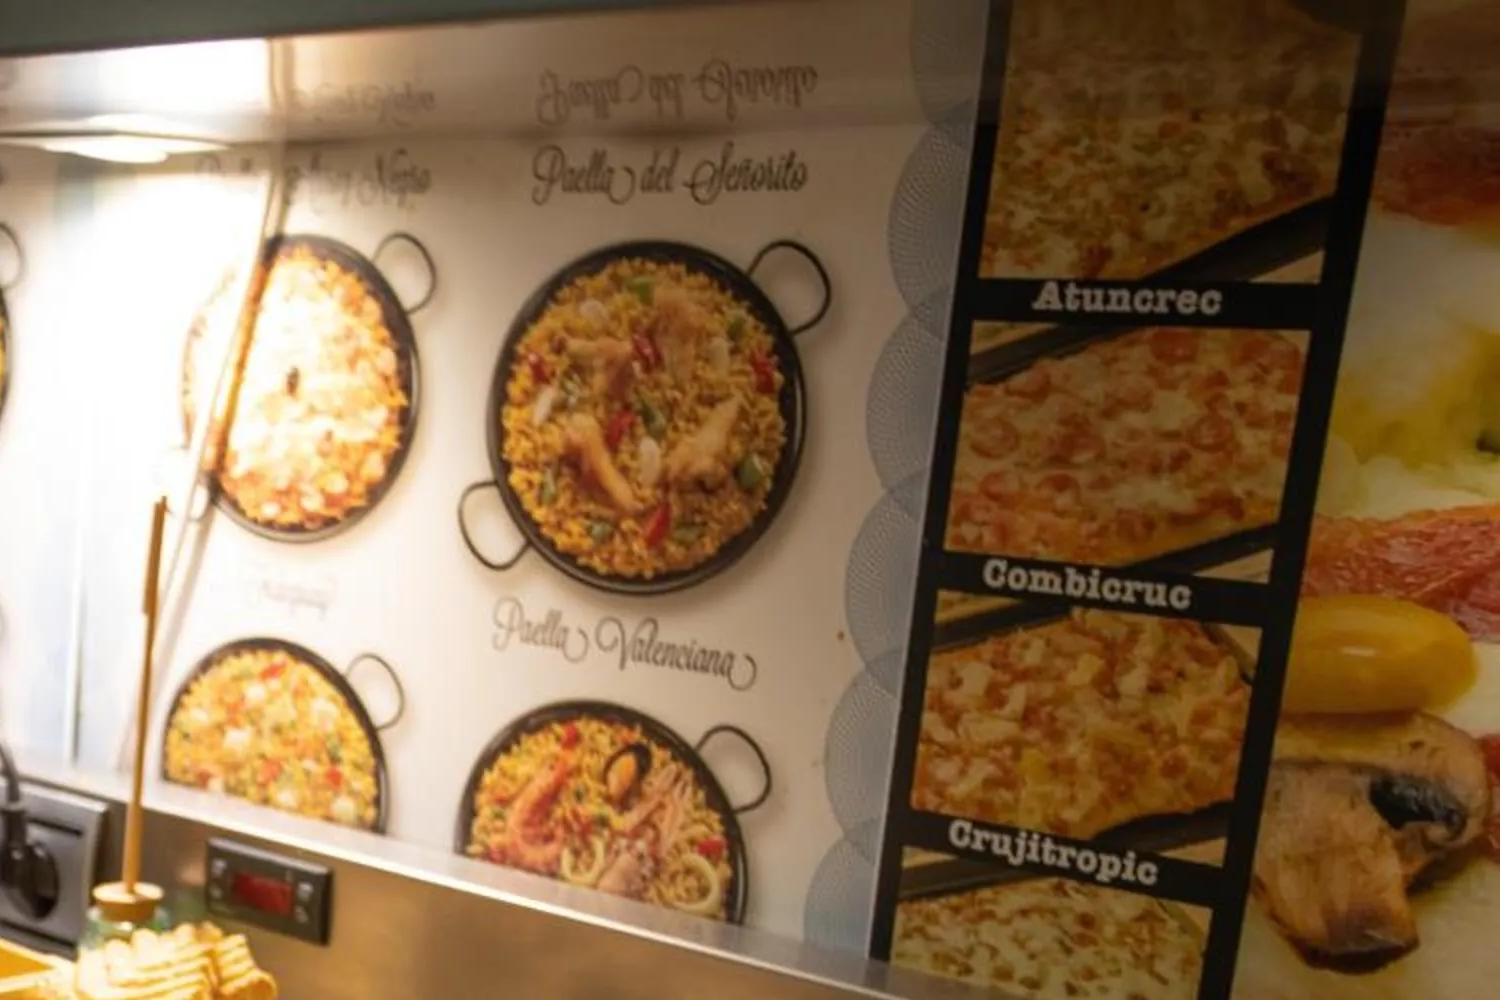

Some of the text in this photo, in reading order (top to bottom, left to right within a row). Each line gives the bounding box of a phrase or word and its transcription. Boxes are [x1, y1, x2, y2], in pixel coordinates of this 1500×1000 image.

[531, 140, 809, 206] Paella del Señorito
[1031, 280, 1223, 316] Atuncrec
[982, 558, 1193, 611] Combicruc
[491, 596, 758, 692] Paella Valenciana
[948, 819, 1159, 885] Crujitropic
